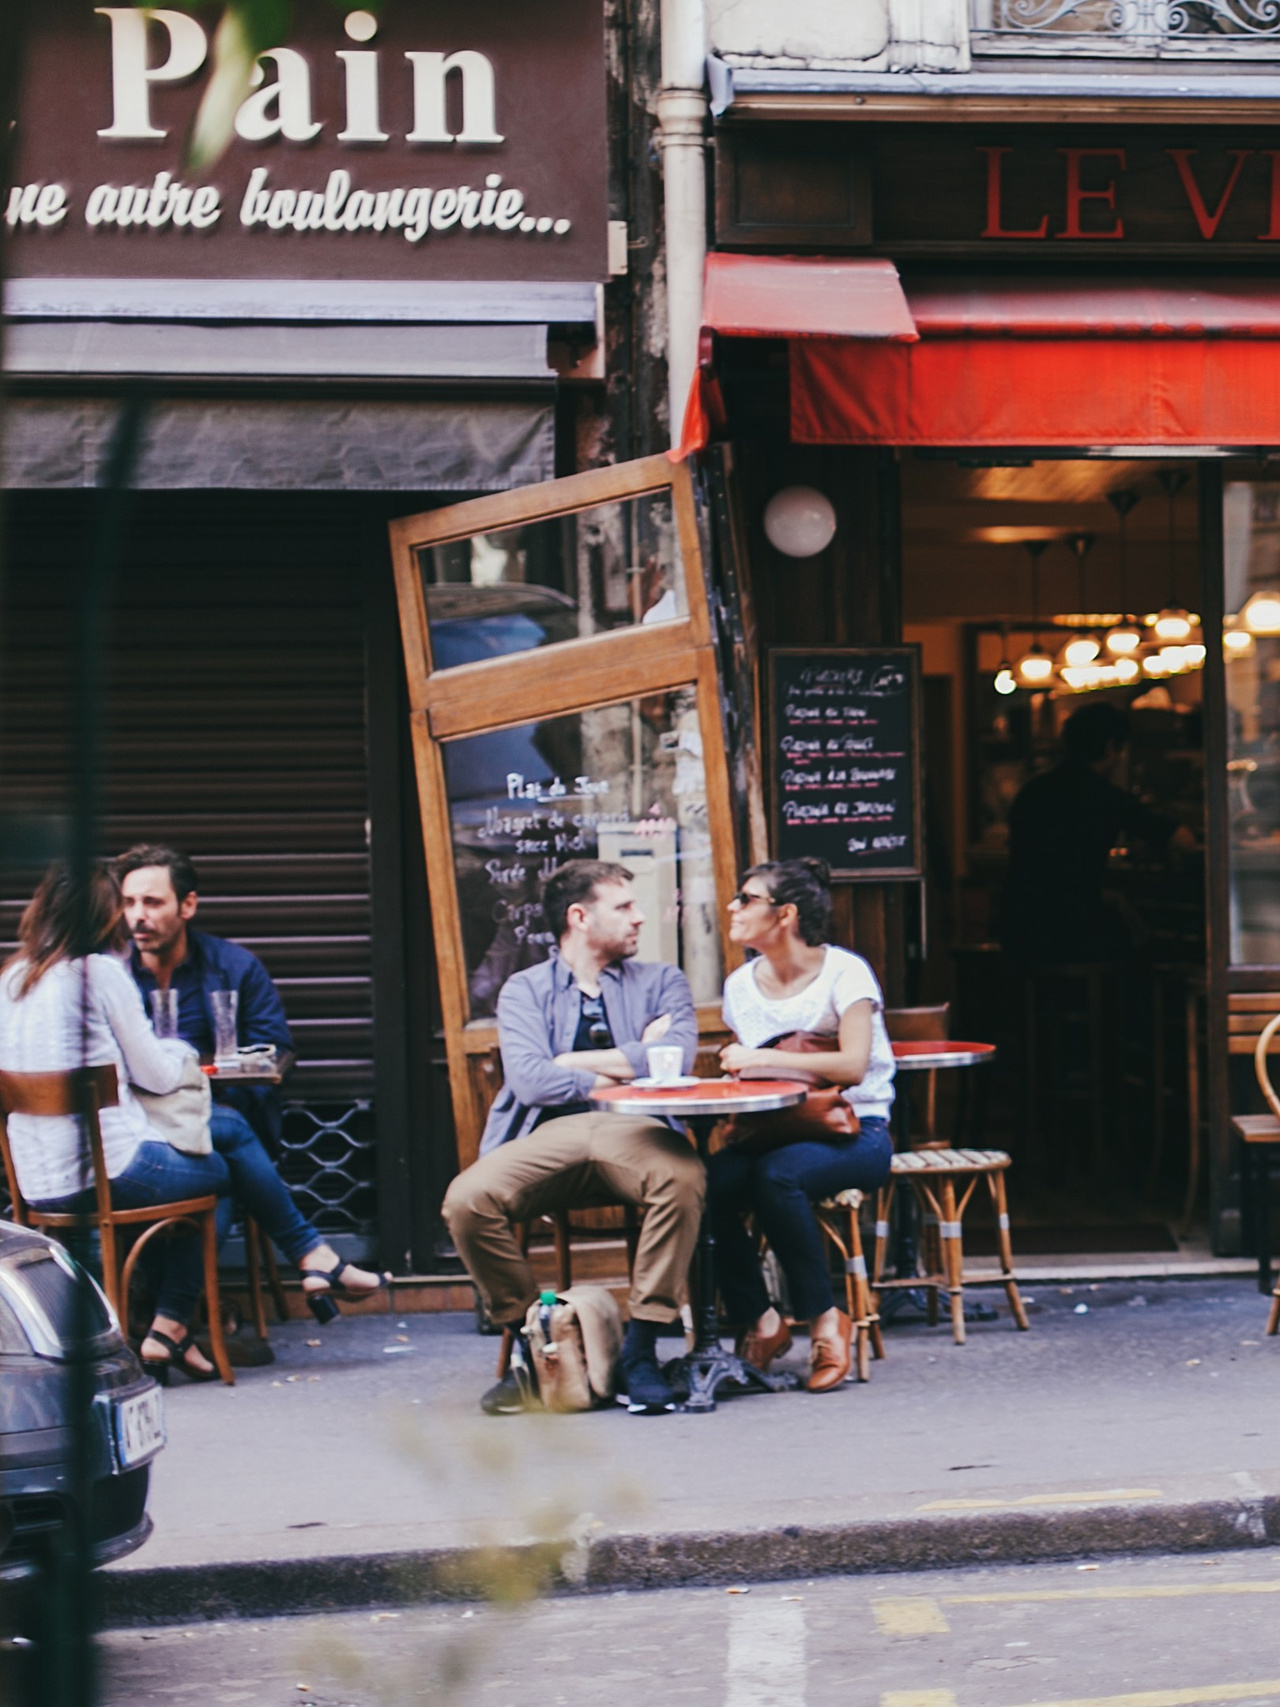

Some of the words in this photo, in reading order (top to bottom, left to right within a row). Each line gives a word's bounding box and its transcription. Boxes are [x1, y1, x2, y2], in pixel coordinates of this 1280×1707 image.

[94, 6, 504, 143] Pain
[86, 172, 221, 228] autre
[240, 167, 572, 241] boulangerie...
[976, 146, 1128, 239] LE
[507, 772, 542, 800] Plat
